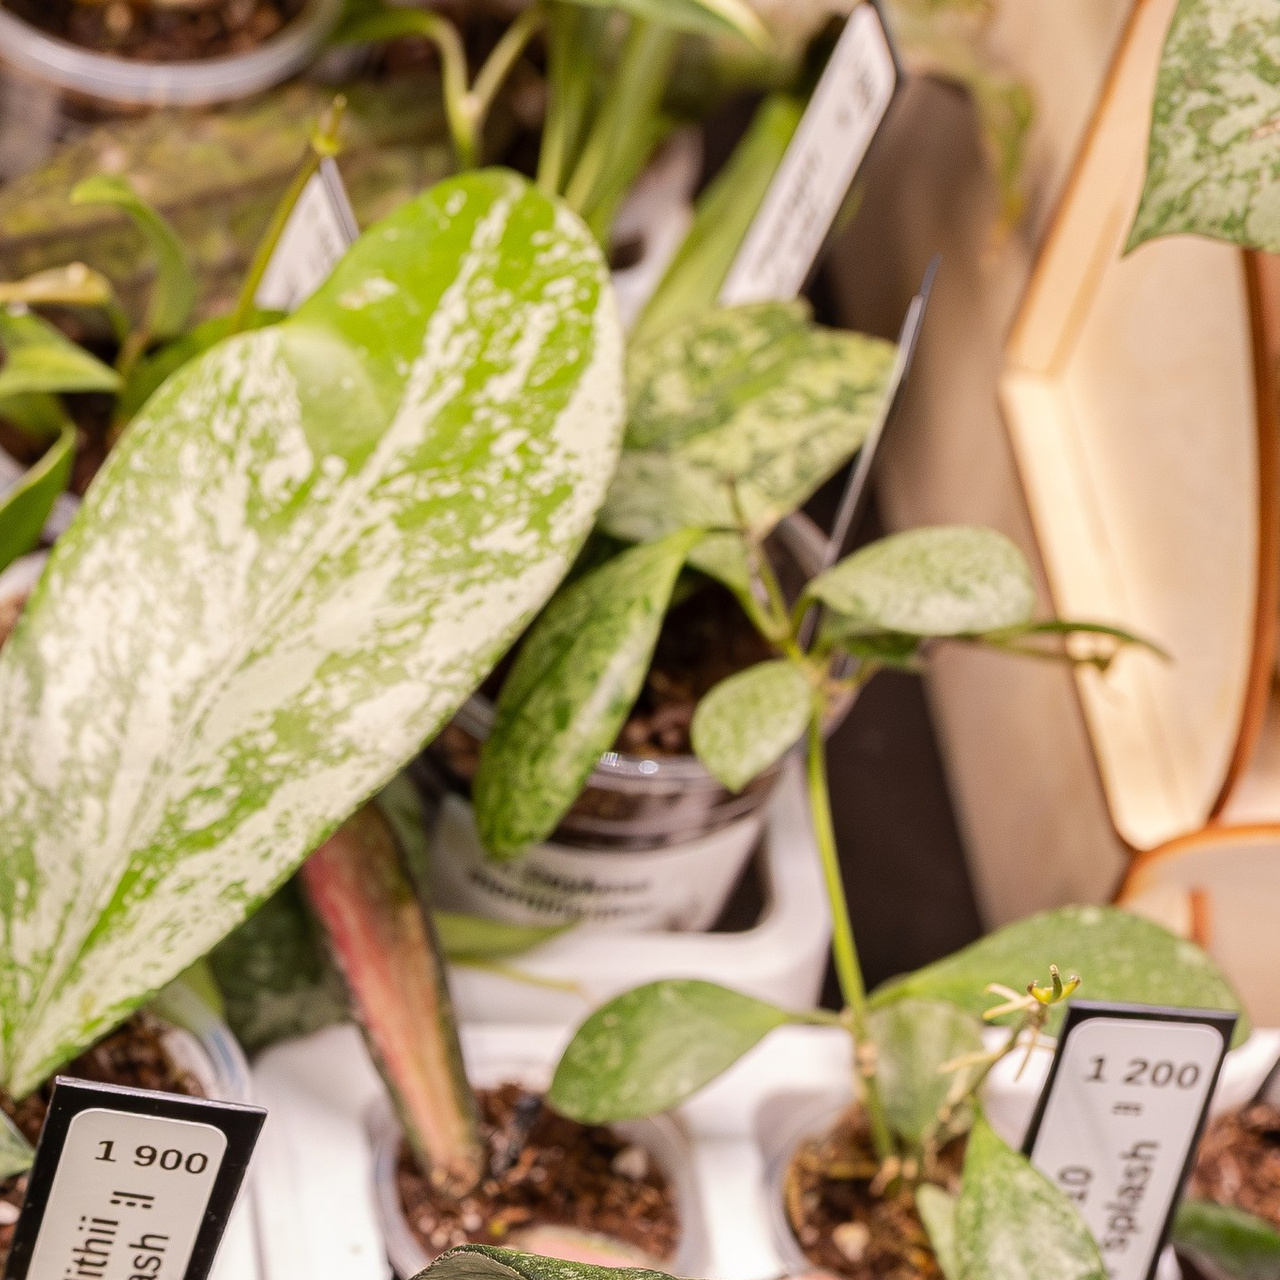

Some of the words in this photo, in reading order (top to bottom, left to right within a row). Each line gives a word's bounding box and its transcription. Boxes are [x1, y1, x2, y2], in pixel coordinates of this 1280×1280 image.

[1084, 1056, 1107, 1084] 1
[1123, 1057, 1202, 1090] 200
[94, 1140, 117, 1163] 1
[133, 1145, 209, 1175] 900
[1102, 1139, 1160, 1254] splash
